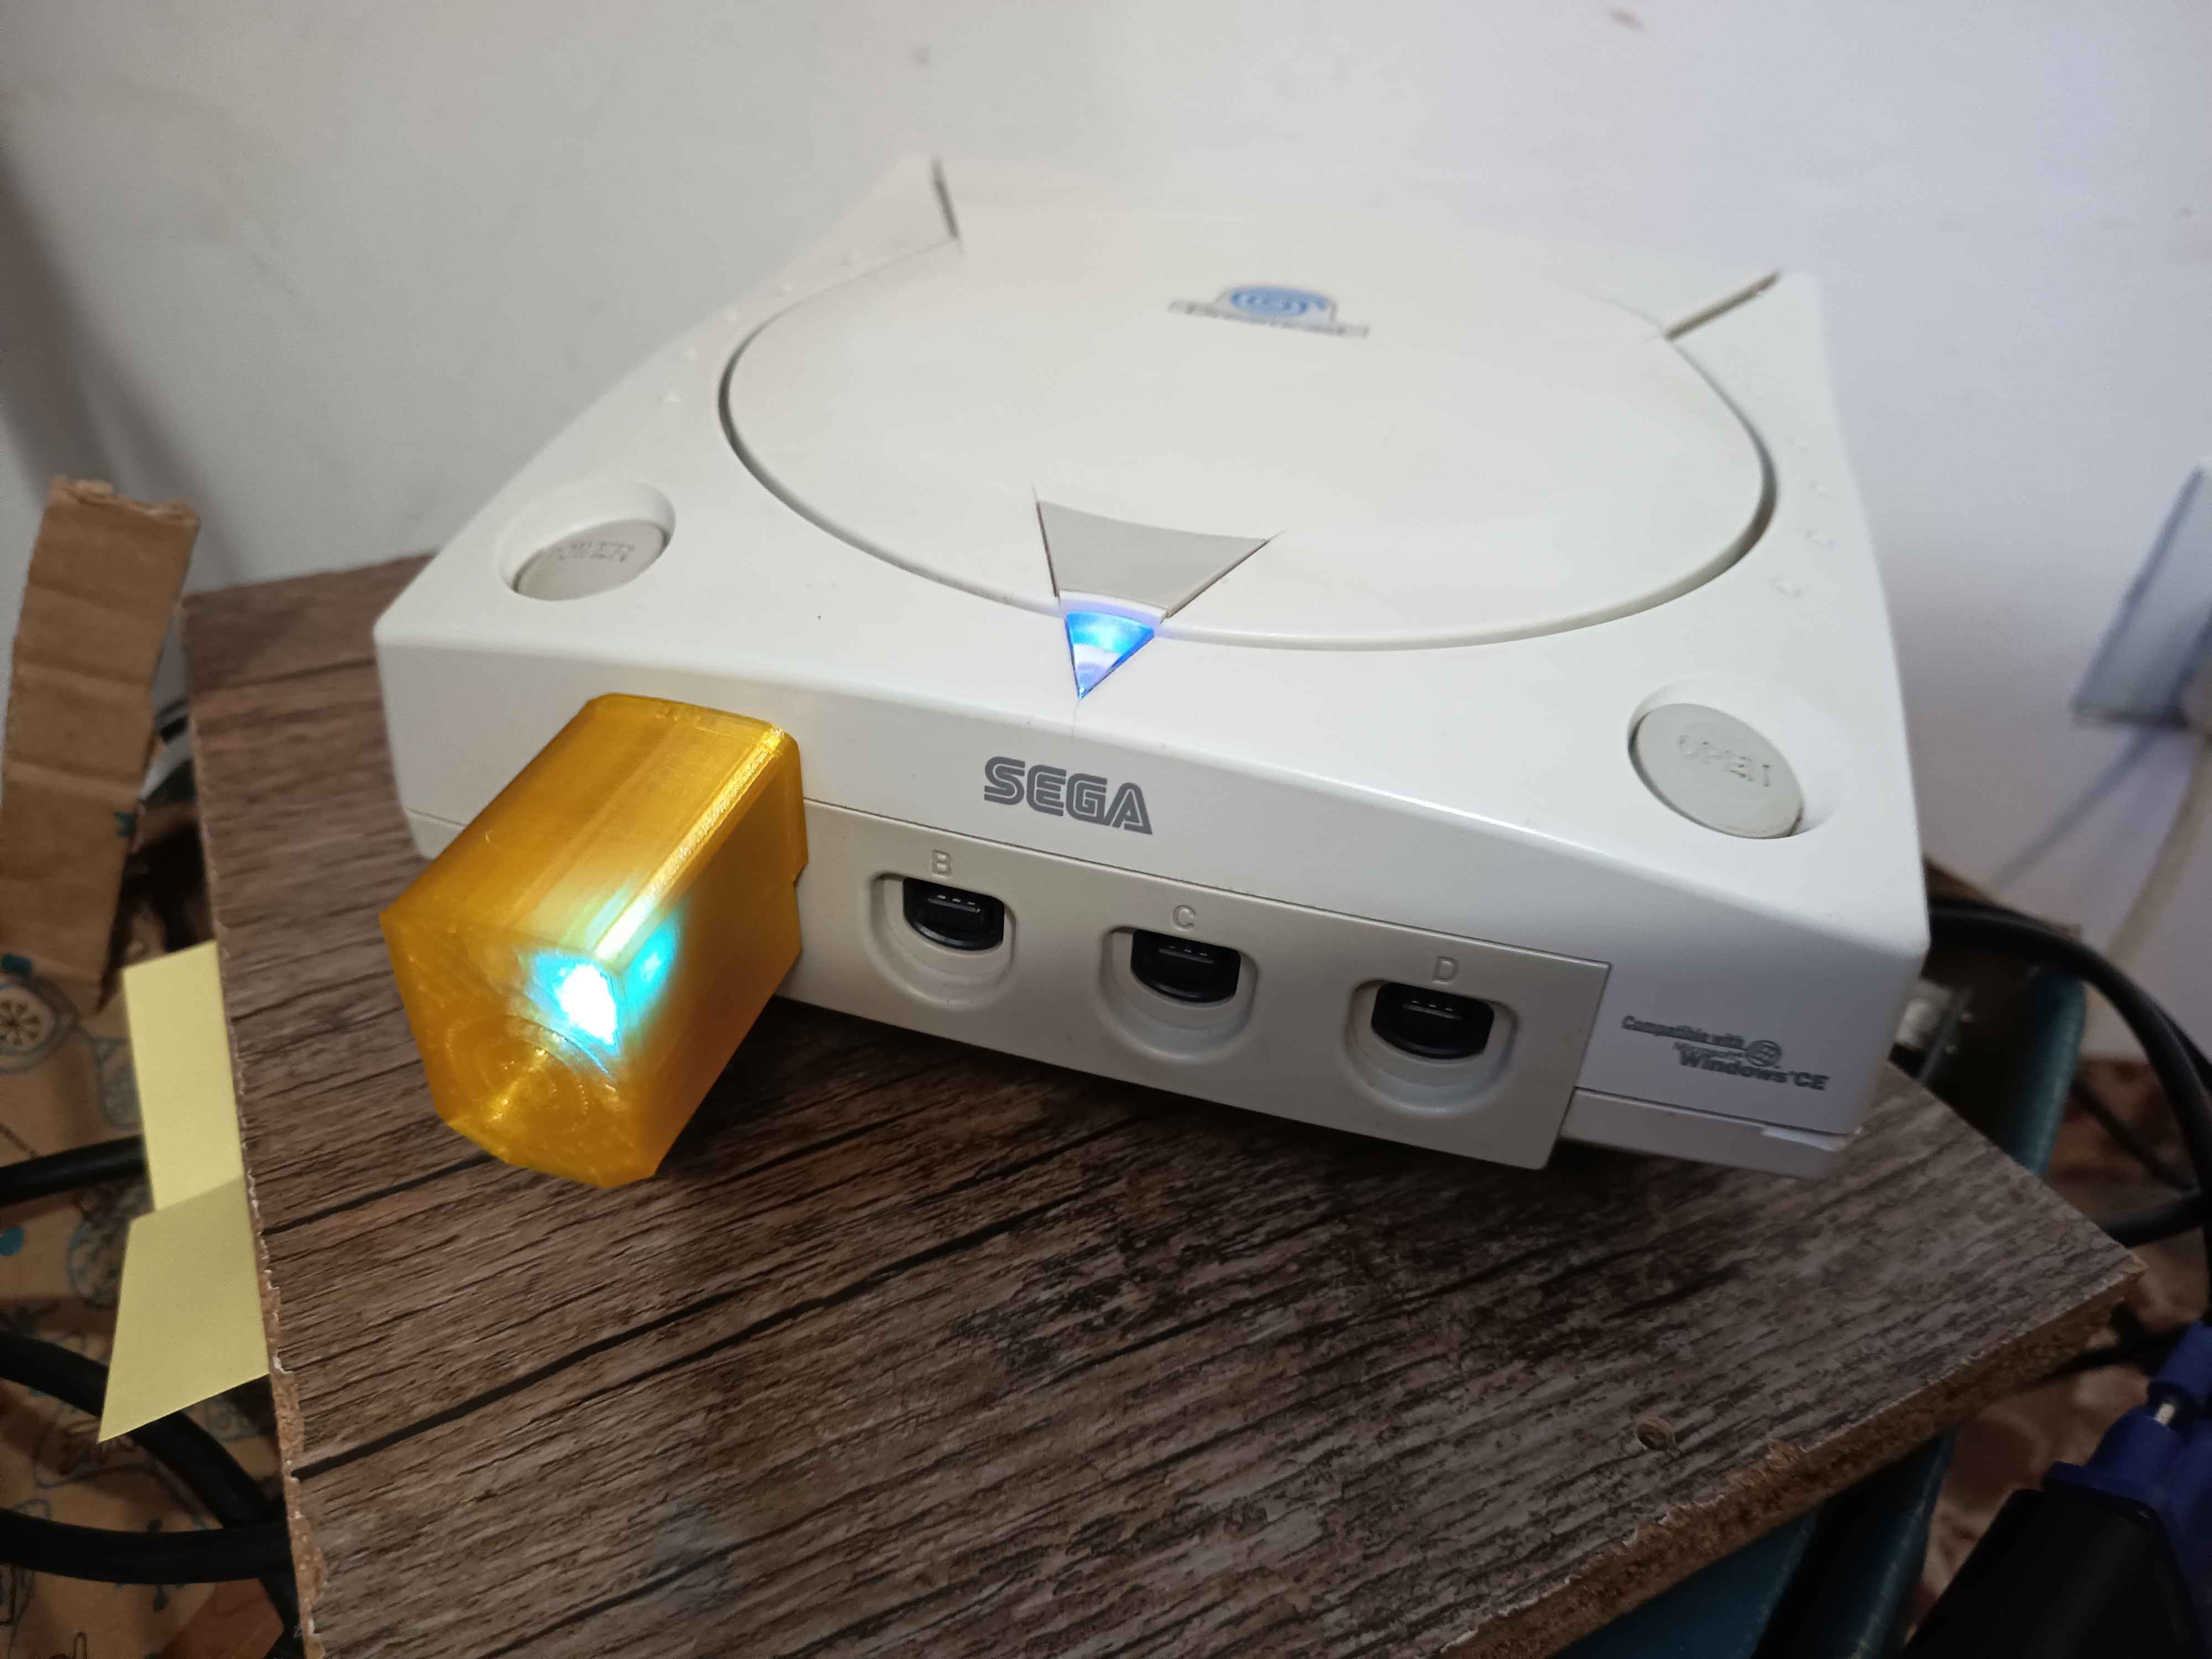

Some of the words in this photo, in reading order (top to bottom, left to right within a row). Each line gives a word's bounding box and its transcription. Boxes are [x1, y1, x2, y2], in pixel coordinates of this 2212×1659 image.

[984, 756, 1154, 835] SEGA
[931, 849, 952, 876] B
[1172, 905, 1196, 930] C
[1432, 956, 1459, 982] D
[1679, 1046, 1787, 1083] Windows
[1793, 1071, 1830, 1091] CE
